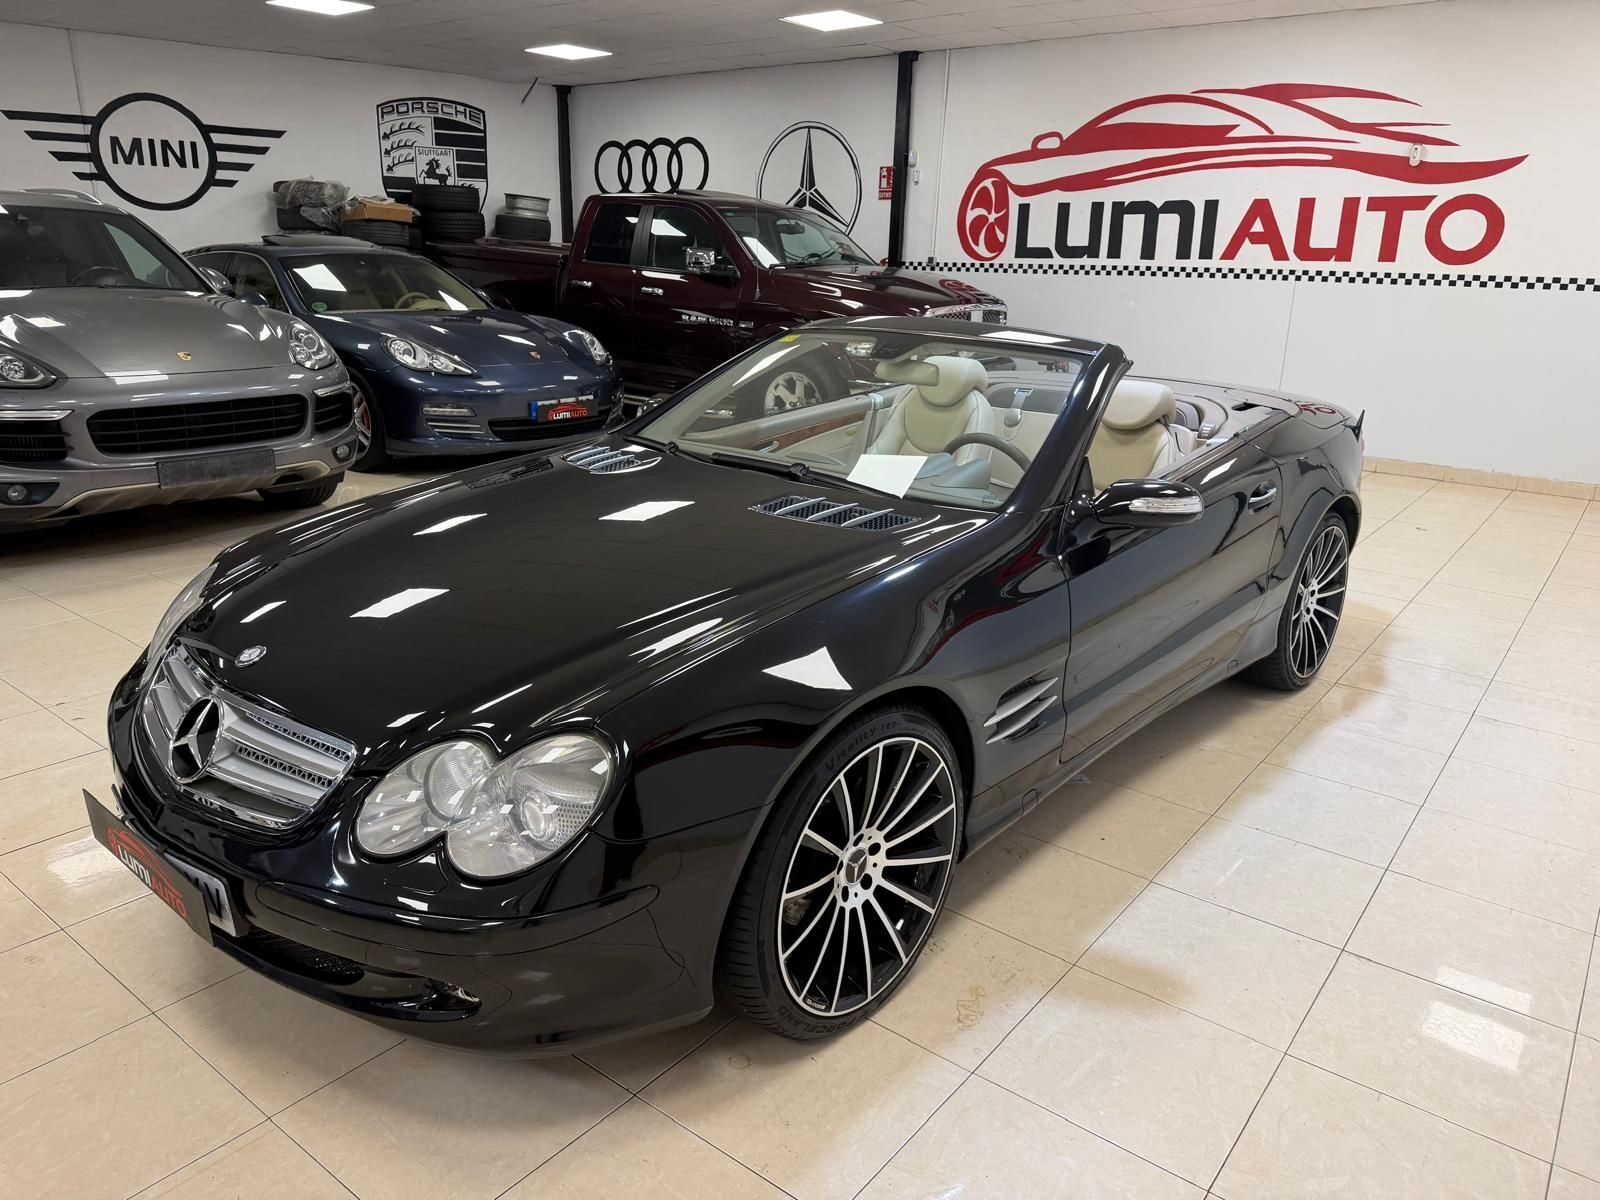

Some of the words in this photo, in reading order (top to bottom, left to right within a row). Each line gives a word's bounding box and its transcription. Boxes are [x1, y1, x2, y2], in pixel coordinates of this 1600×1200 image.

[380, 101, 482, 125] PORSCHE
[110, 136, 199, 169] MINI
[417, 148, 451, 157] STUTTGART
